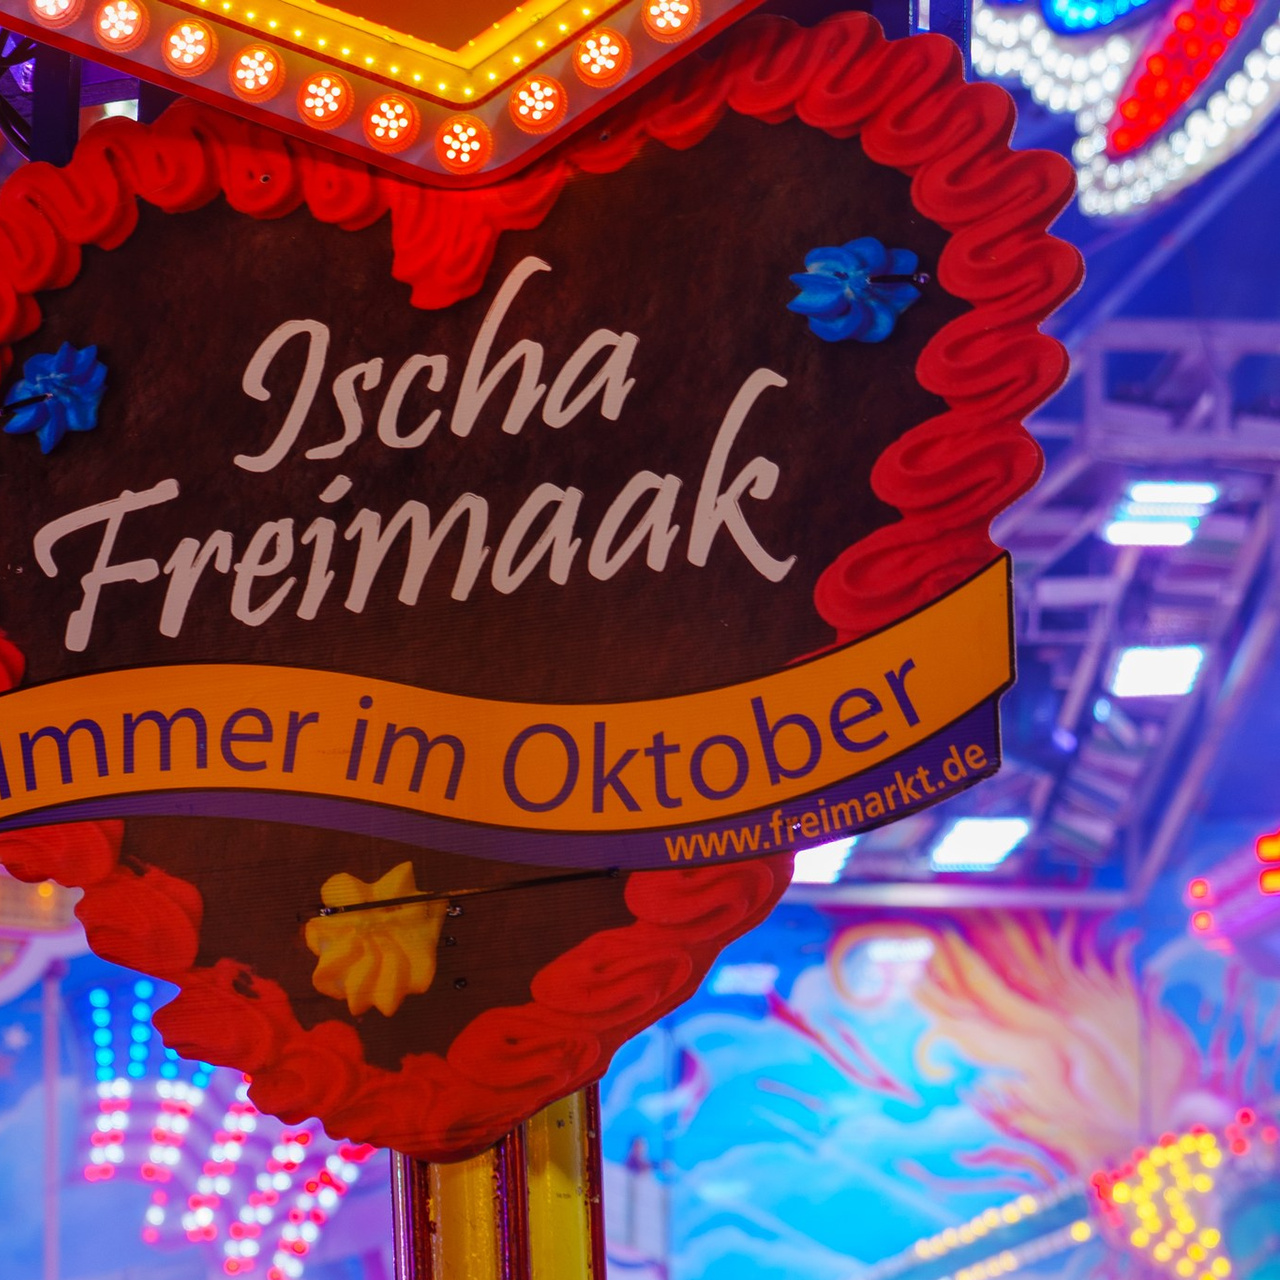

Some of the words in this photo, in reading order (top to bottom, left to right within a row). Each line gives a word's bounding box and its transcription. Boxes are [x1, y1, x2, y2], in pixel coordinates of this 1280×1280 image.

[232, 255, 641, 474] Ischa
[32, 366, 798, 653] Freimaak
[344, 696, 466, 801] im
[502, 656, 920, 814] Oktober
[664, 743, 988, 862] www.freimarkt.de
